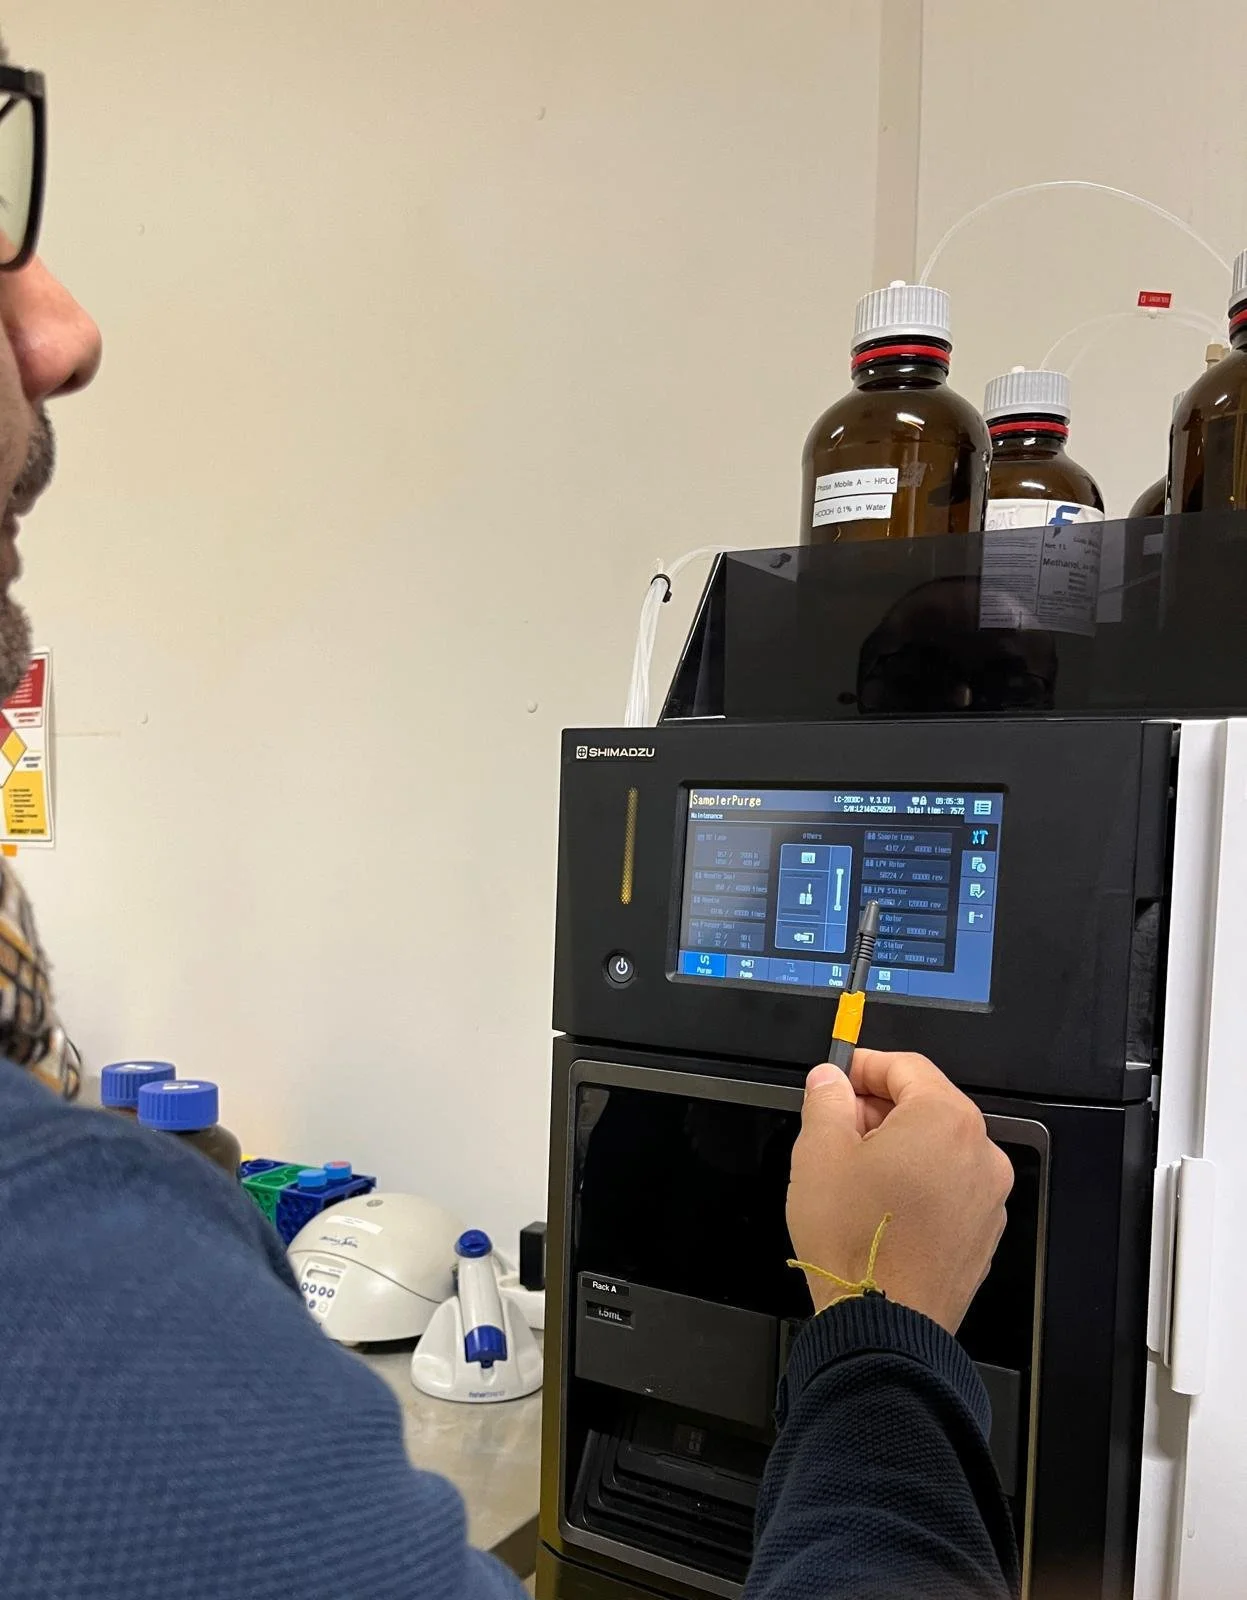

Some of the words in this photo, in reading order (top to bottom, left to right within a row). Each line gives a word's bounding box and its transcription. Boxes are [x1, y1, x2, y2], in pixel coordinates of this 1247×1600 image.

[834, 480, 853, 488] Mobile
[874, 477, 896, 485] HPLC
[837, 505, 852, 514] 0.1%
[865, 503, 887, 511] Water
[588, 747, 656, 758] SHIMADZU
[692, 794, 762, 808] SamplerPurge
[690, 812, 724, 820] Maintenance
[906, 806, 924, 814] Total
[927, 806, 944, 815] time:
[876, 982, 891, 991] Zero
[592, 1280, 609, 1291] Rack
[611, 1285, 617, 1293] A
